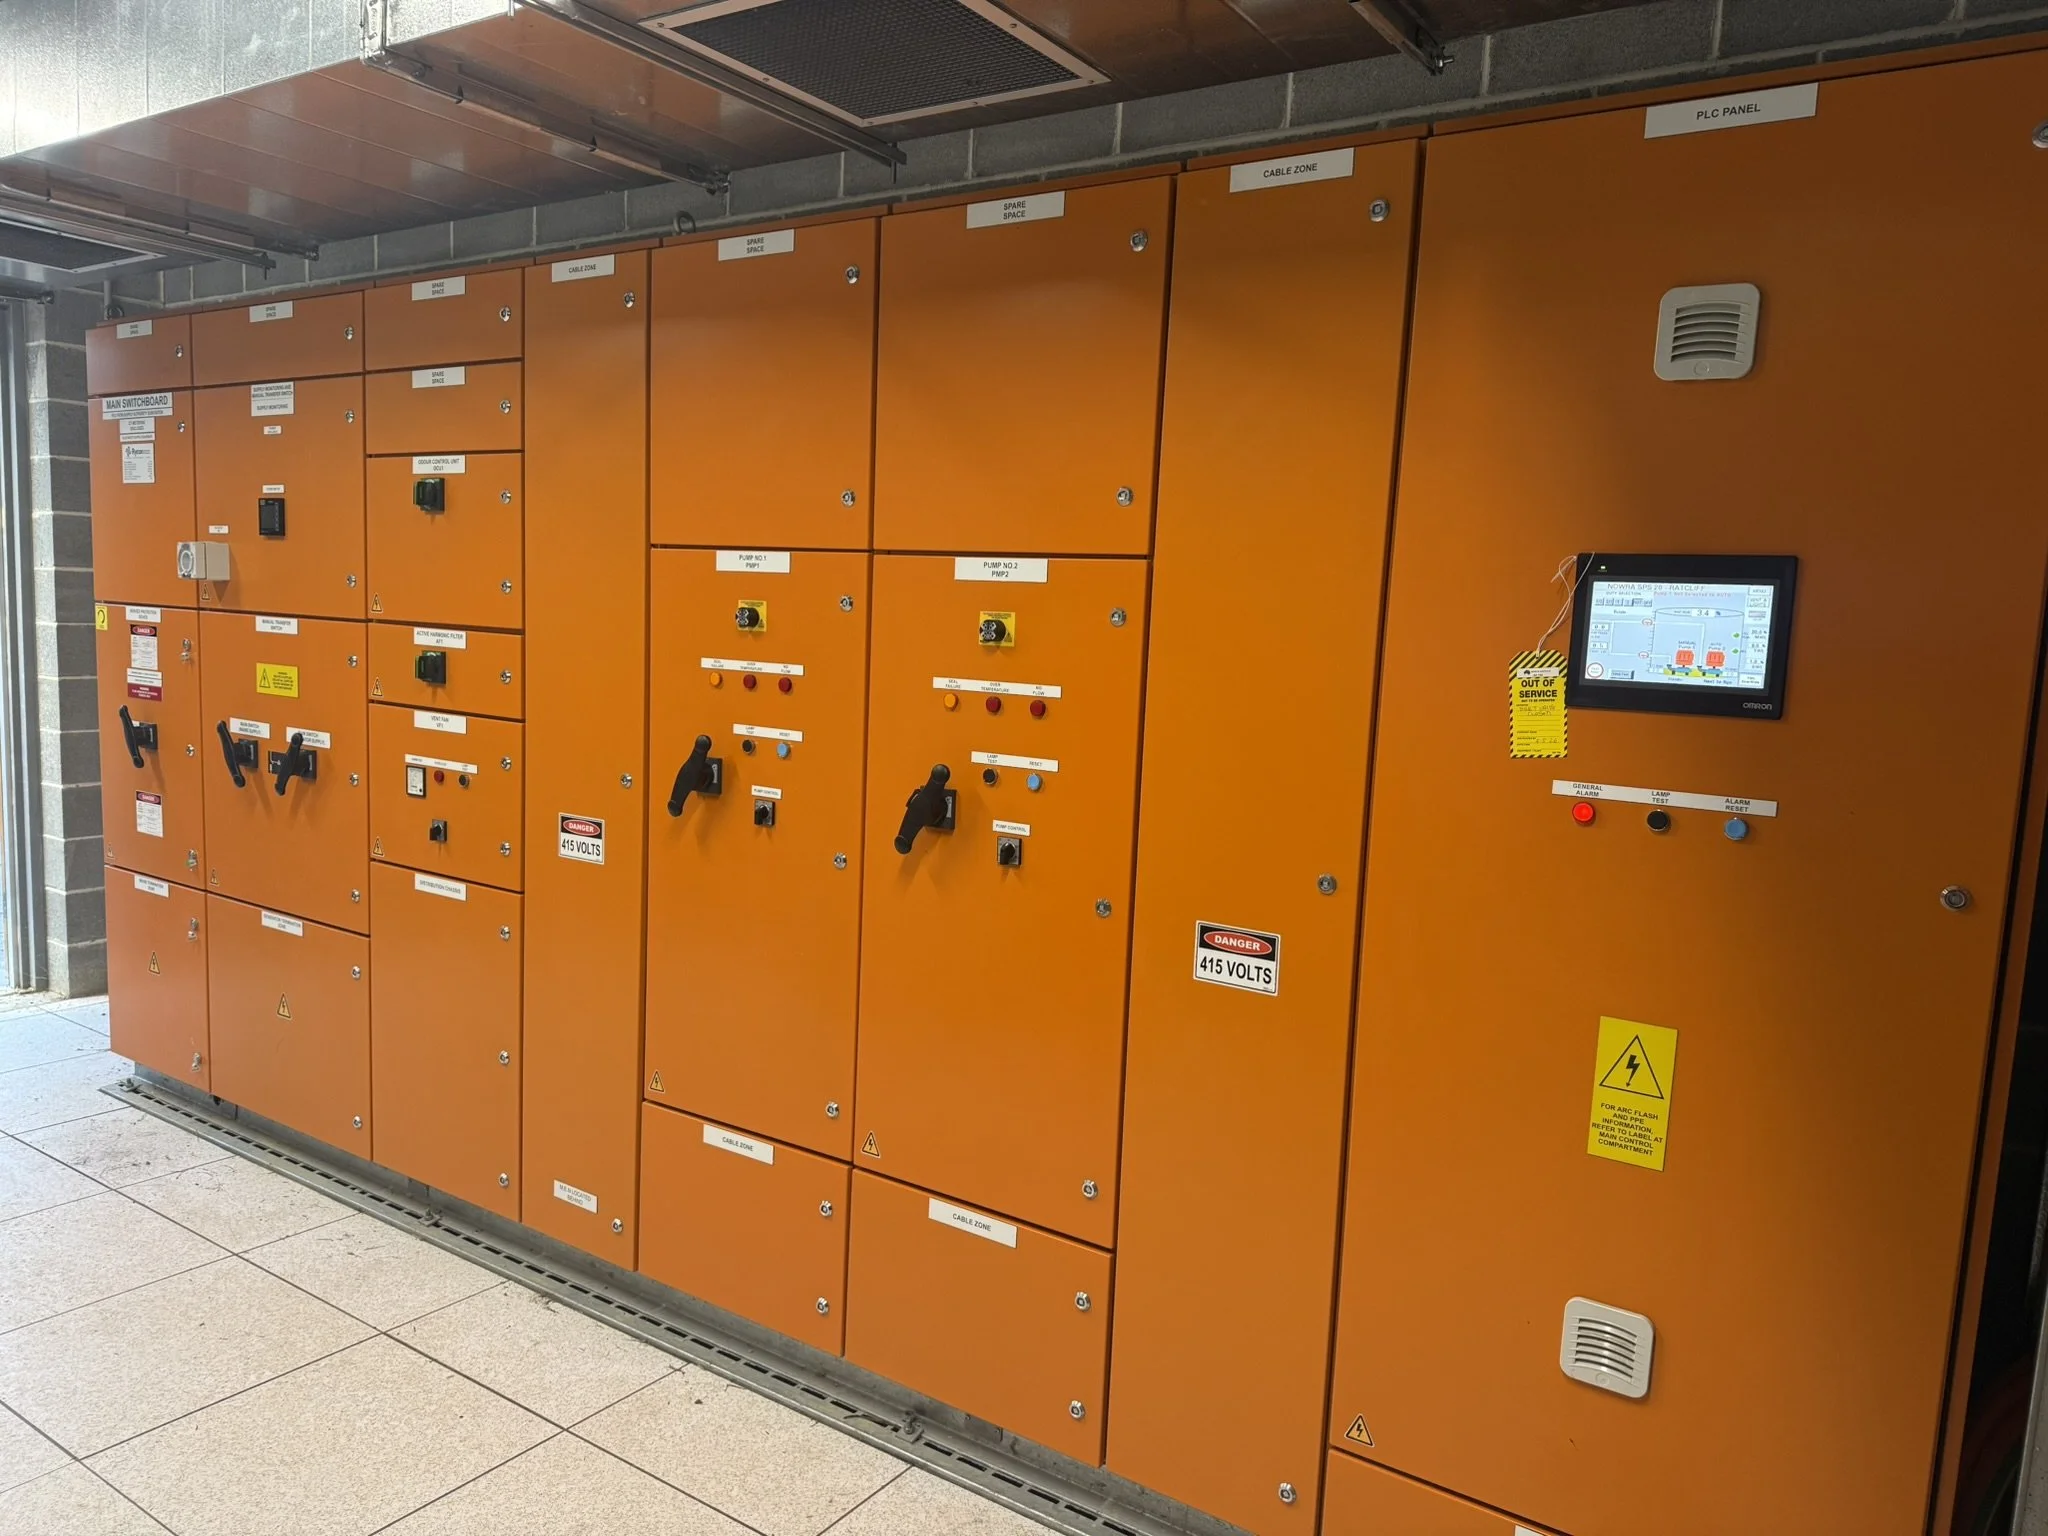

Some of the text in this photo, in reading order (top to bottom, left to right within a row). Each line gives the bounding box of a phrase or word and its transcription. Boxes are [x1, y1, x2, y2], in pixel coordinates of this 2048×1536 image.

[1697, 103, 1760, 120] PLC PANEL
[1263, 163, 1318, 178] CABLE ZONE
[1004, 200, 1026, 210] SPARE
[1003, 210, 1025, 220] SPACE
[746, 237, 764, 245] SPARE
[746, 245, 764, 254] SPACE
[106, 395, 168, 409] MAIN SWITCHBOARD
[1519, 690, 1557, 698] SERVICE
[1572, 783, 1603, 791] GENERAL
[1725, 798, 1750, 806] ALARM
[569, 822, 594, 832] DANGER
[562, 838, 600, 856] 415 VOLTS
[1214, 935, 1260, 951] DANGER
[1200, 956, 1272, 984] 415 VOLTS
[1601, 1102, 1615, 1111] FOR
[1634, 1110, 1658, 1120] FLASH
[1592, 1122, 1615, 1132] REFER
[1629, 1130, 1652, 1141] LABEL
[1602, 1118, 1653, 1134] INFORMATION,
[722, 1137, 754, 1151] CABLE ZONE
[1598, 1138, 1653, 1156] COMPARTMENT
[1599, 1131, 1653, 1149] MAIN CONTROL
[952, 1213, 991, 1232] CABLE ZONE
